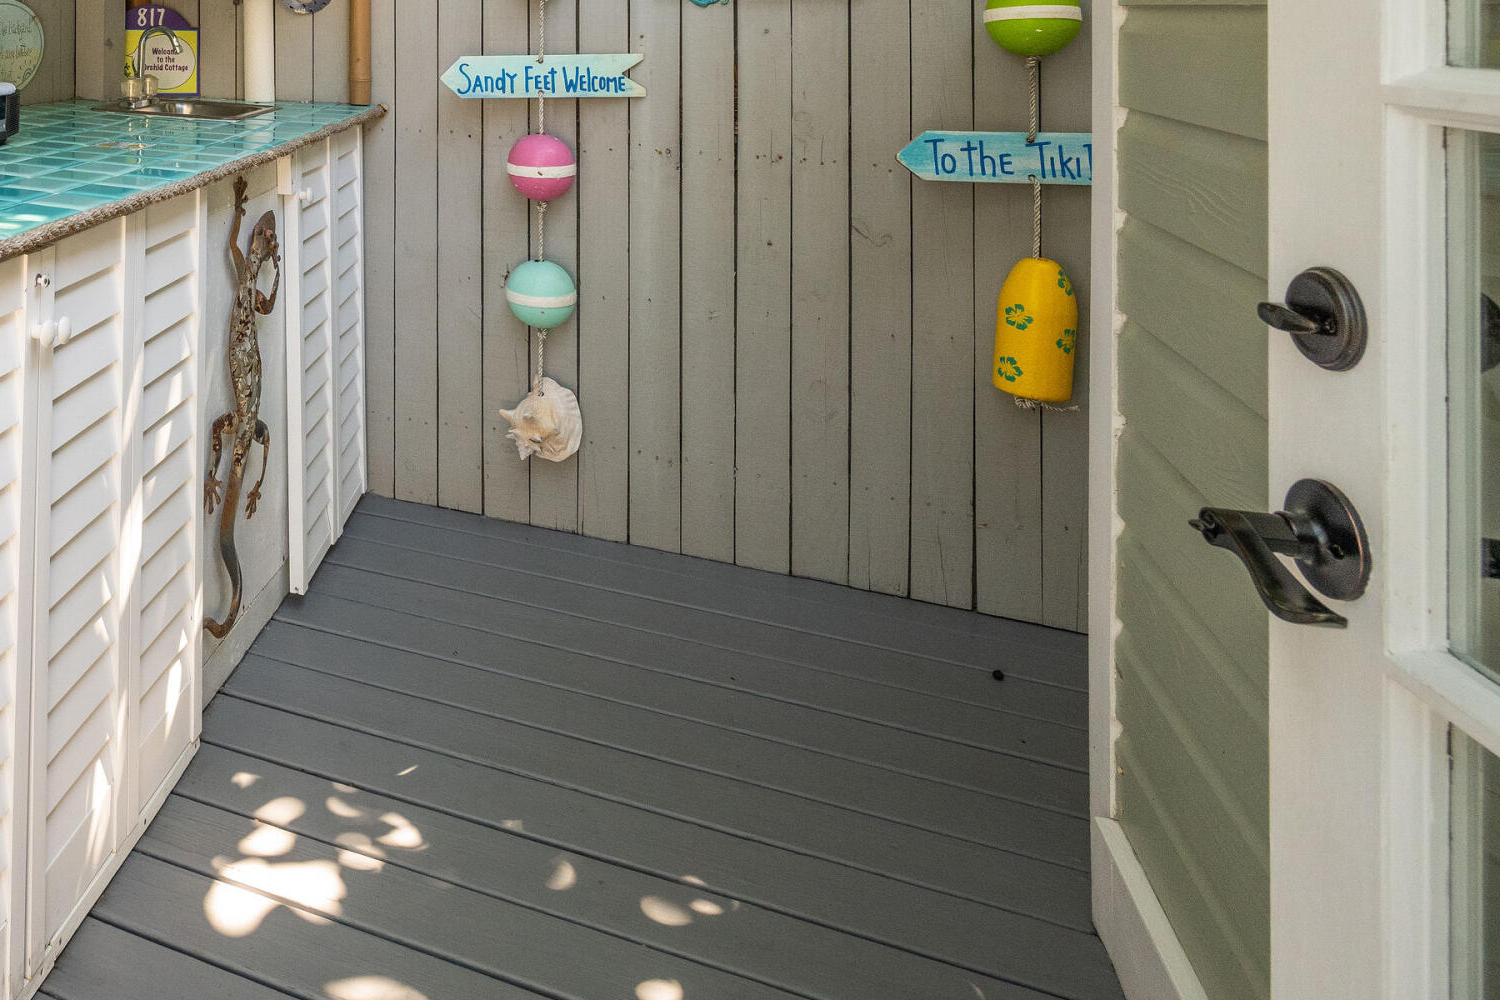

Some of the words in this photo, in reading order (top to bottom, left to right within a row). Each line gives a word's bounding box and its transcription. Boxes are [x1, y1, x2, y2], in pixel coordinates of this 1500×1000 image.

[137, 8, 165, 27] 817
[152, 47, 179, 55] Welcom
[165, 64, 188, 72] Cottage
